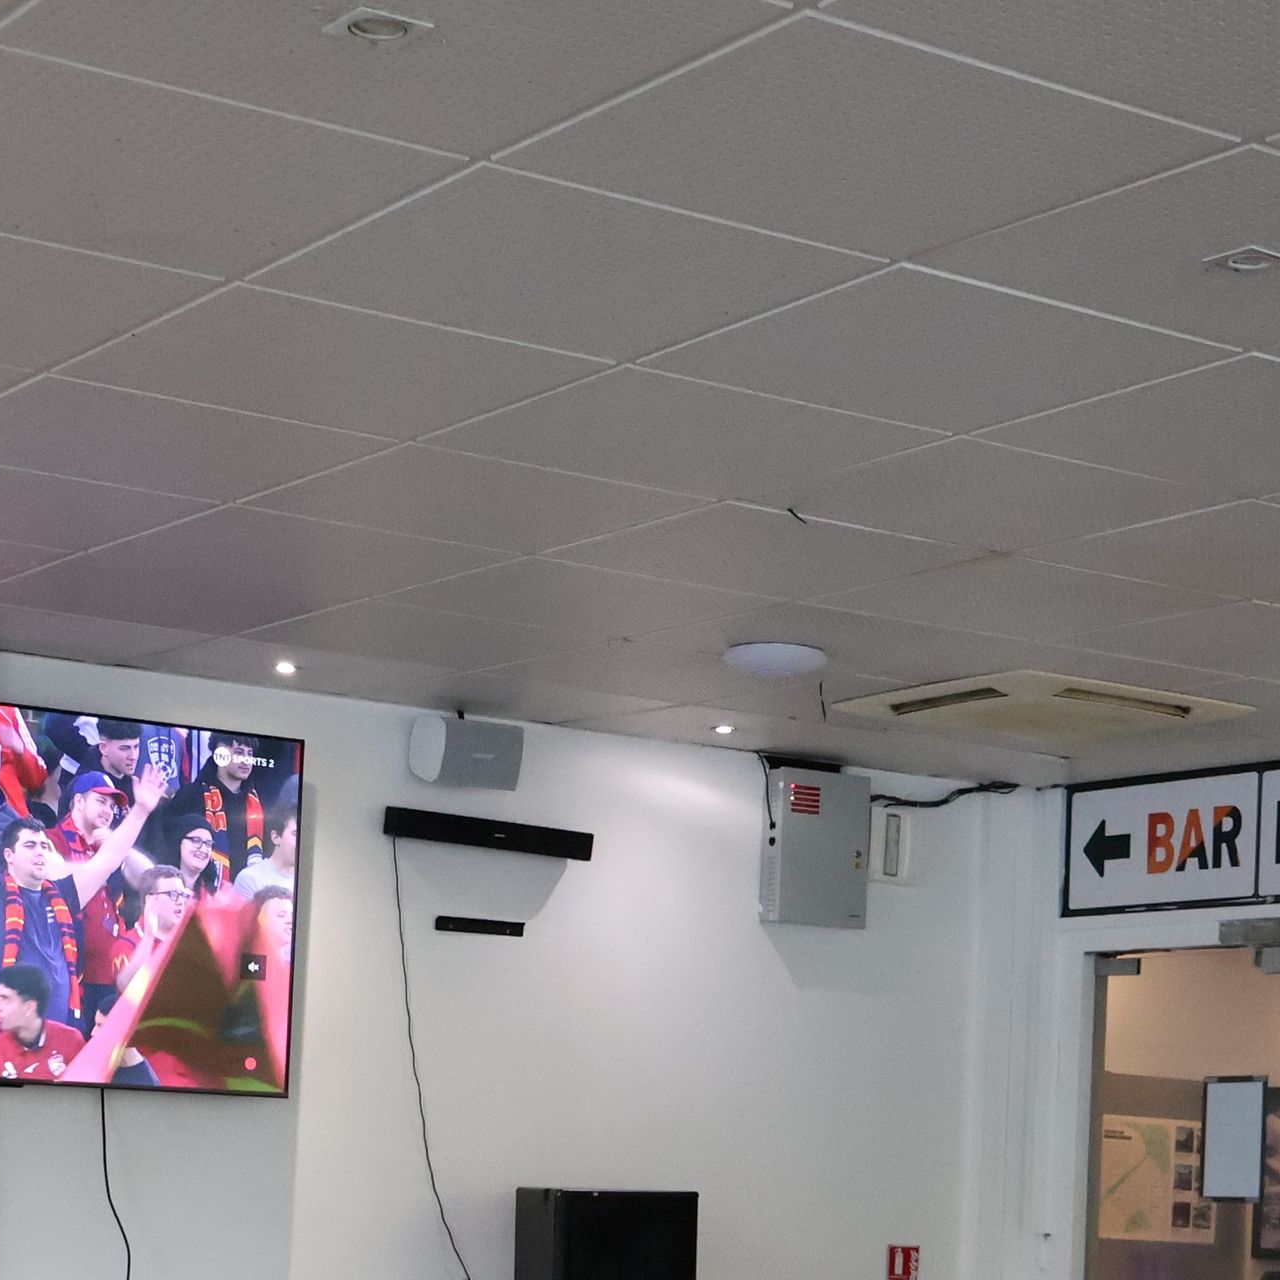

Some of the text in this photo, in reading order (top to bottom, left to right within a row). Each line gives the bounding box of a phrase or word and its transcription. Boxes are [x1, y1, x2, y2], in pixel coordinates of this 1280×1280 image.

[232, 754, 268, 768] SPORTS
[268, 758, 275, 768] 2
[1147, 805, 1242, 874] BAR
